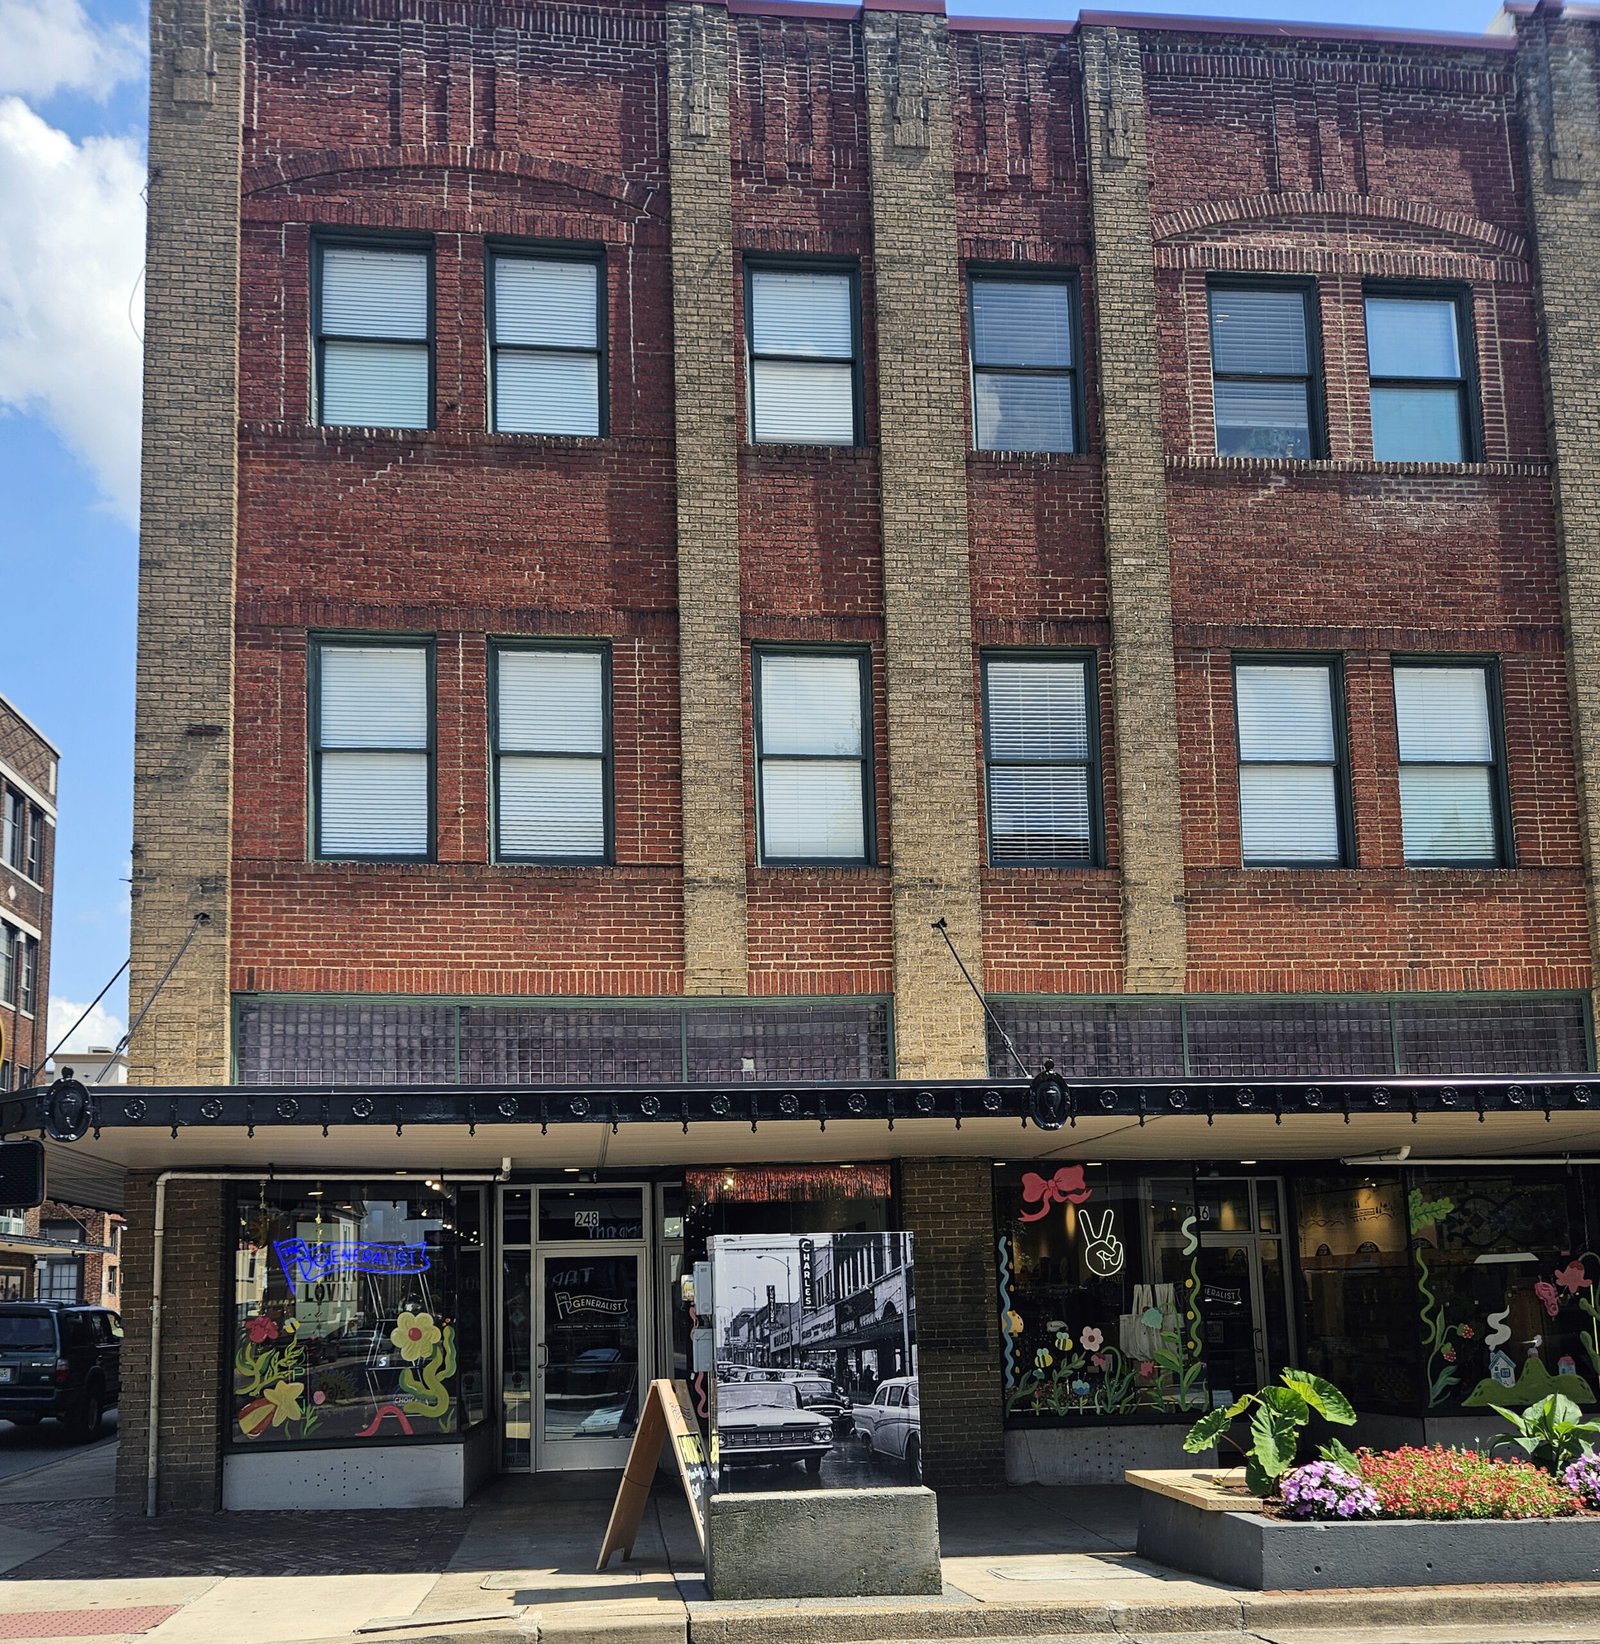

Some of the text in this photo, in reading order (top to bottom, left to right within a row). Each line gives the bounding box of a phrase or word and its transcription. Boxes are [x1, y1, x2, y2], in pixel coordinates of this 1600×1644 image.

[575, 1212, 598, 1226] 248
[1186, 1206, 1209, 1220] 26
[313, 1249, 417, 1269] GENERALIST
[801, 1240, 812, 1304] CHARLES
[1204, 1288, 1235, 1300] ERALIST
[573, 1298, 622, 1311] GENERALIST
